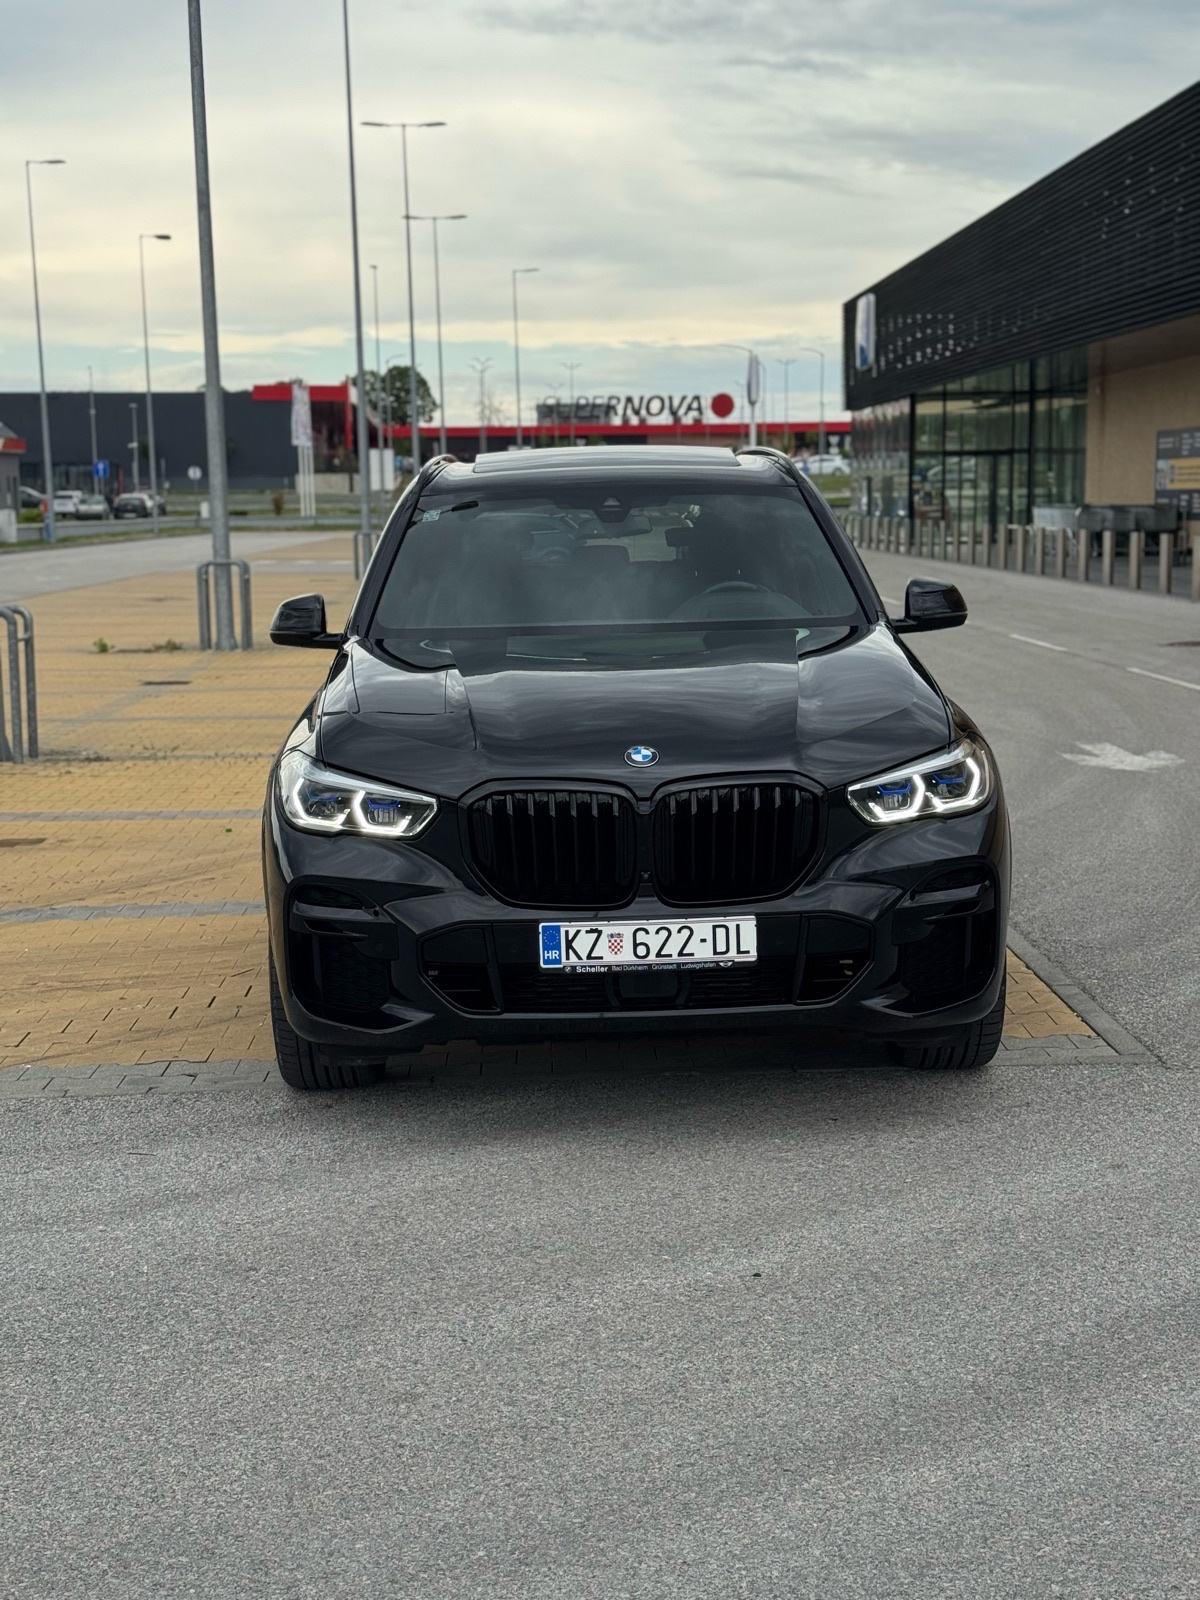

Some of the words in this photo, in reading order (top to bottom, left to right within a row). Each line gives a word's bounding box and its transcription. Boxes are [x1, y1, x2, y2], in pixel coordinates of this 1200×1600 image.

[632, 923, 751, 960] 622-DL
[544, 949, 559, 959] HR
[575, 965, 608, 973] Scheller
[680, 961, 717, 970] Ludwigshafen
